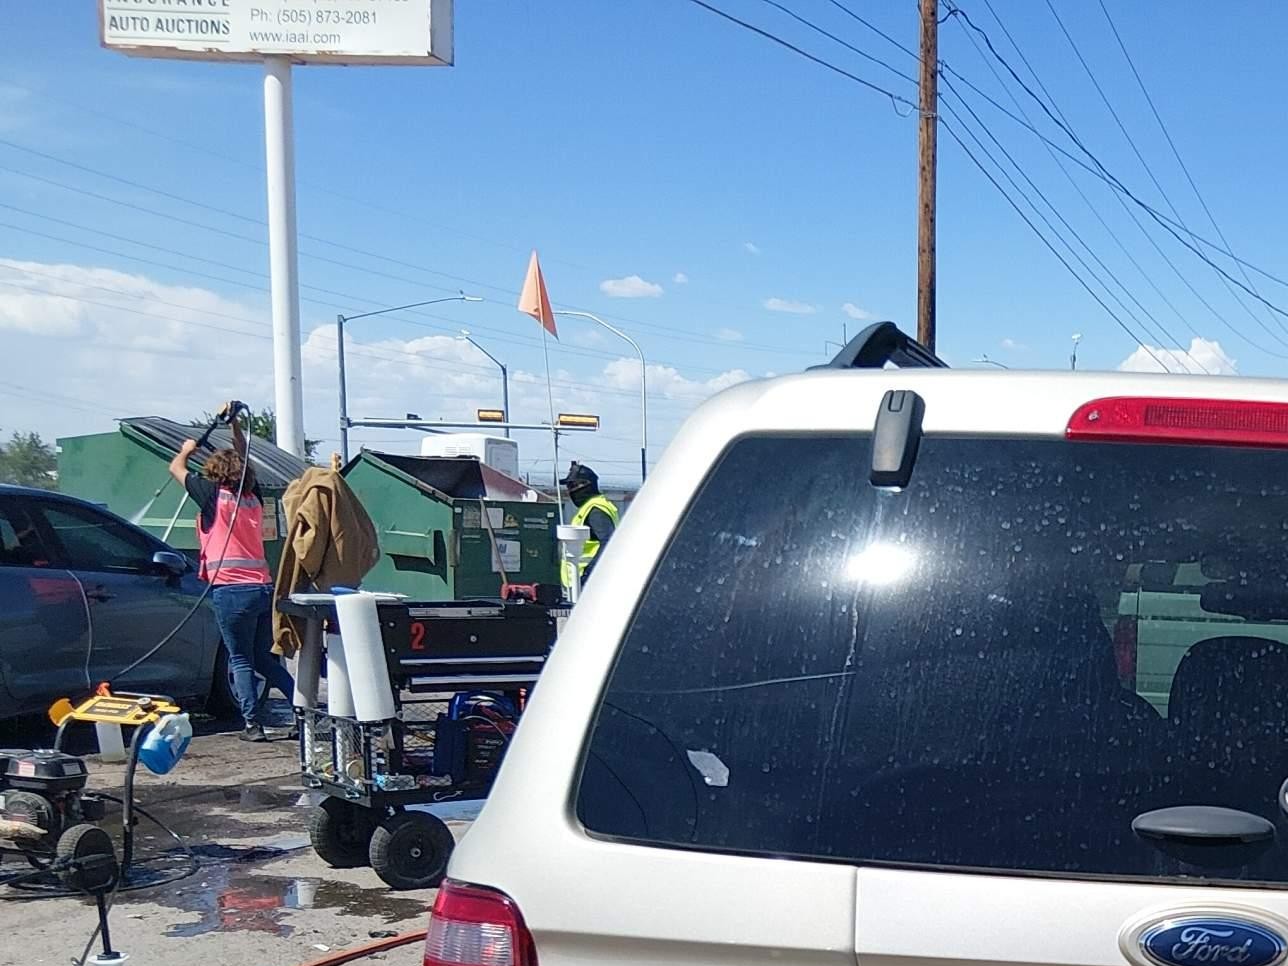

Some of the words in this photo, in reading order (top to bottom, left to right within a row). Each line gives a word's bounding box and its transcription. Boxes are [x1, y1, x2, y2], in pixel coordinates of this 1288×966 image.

[109, 16, 149, 31] AUTO
[155, 18, 230, 35] AUCTIONS
[250, 8, 272, 22] Ph:
[277, 10, 312, 25] (505)
[316, 11, 377, 25] 873-2081
[249, 30, 341, 44] www.iaai.com
[411, 622, 424, 650] 2
[1172, 927, 1253, 963] Ford
